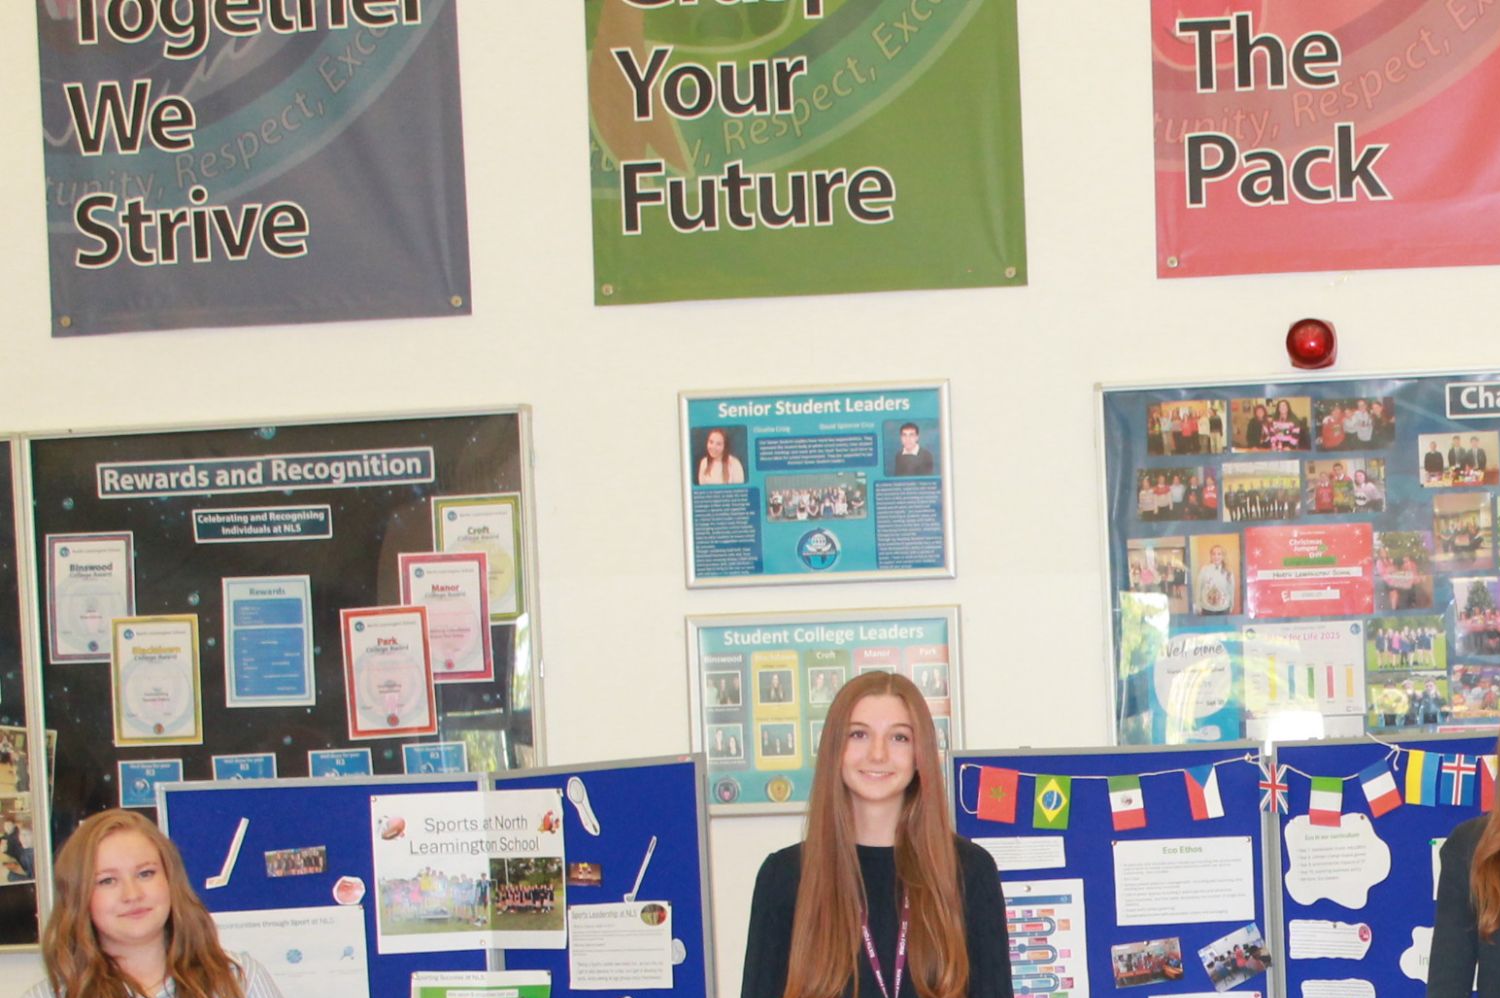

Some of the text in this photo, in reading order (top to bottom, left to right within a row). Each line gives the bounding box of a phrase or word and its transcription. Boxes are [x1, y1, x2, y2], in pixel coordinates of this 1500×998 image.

[1176, 12, 1342, 94] The
[611, 45, 807, 121] Your
[1291, 27, 1452, 128] Respect,
[66, 80, 197, 155] We
[174, 82, 328, 188] Respect,
[1185, 122, 1393, 209] Pack
[620, 160, 896, 236] Future
[75, 186, 309, 268] Strive
[718, 396, 911, 418] Senior Student Leaders
[104, 453, 422, 492] Rewards and Recognition
[197, 510, 325, 525] Celebrating and Recognising
[221, 523, 302, 535] Individuals at NLS
[467, 525, 491, 535] Croft
[69, 562, 113, 573] Binswood
[249, 588, 286, 596] Rewards
[431, 584, 460, 593] Manor
[376, 636, 399, 646] Park
[724, 624, 925, 647] Student College Leaders
[1302, 630, 1318, 640] Life
[1320, 631, 1341, 641] 2025
[815, 650, 837, 661] Croft
[863, 649, 891, 659] Manor
[919, 647, 937, 656] Park
[424, 814, 529, 835] Sports at North
[409, 835, 540, 856] Leamington School
[1162, 845, 1203, 854] Eco Ethos
